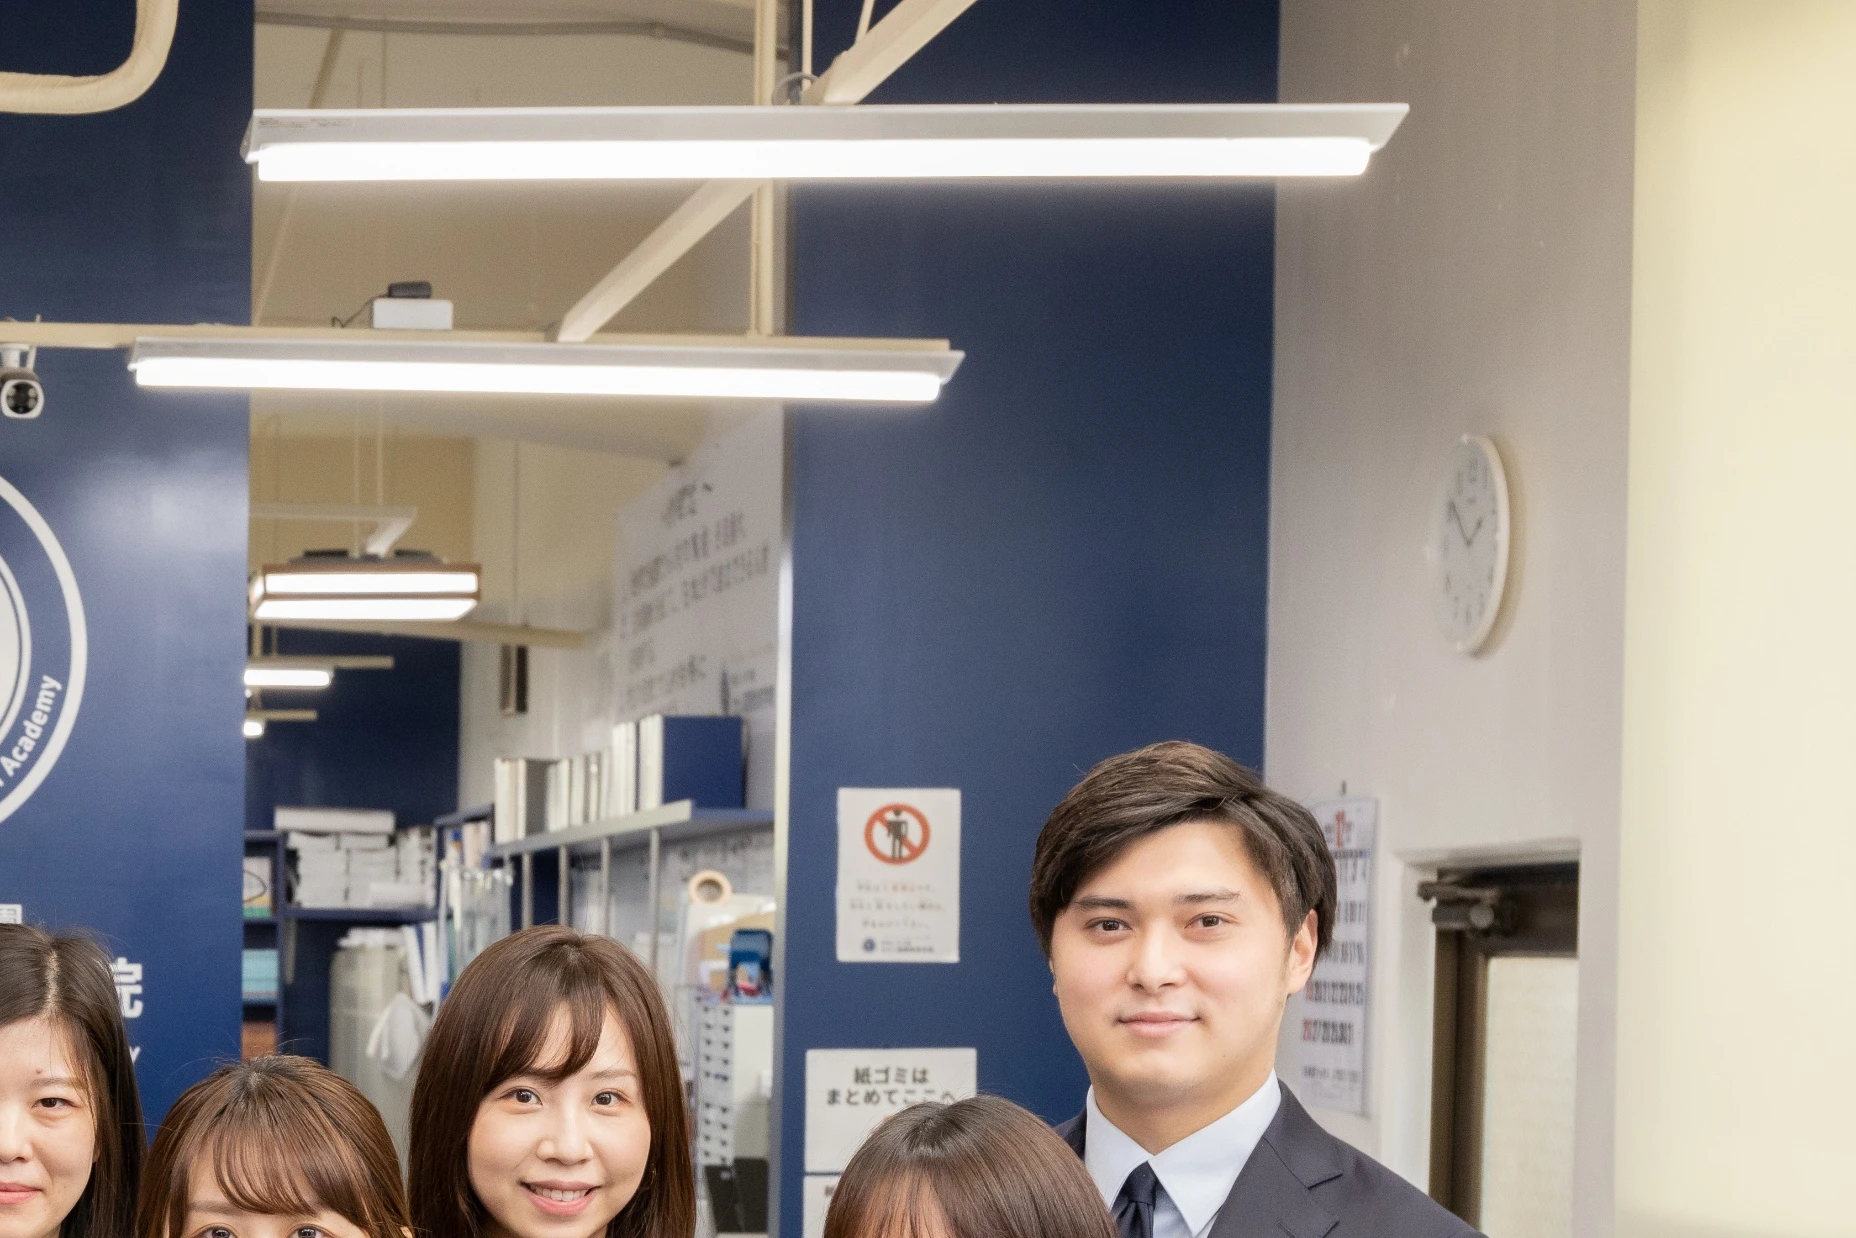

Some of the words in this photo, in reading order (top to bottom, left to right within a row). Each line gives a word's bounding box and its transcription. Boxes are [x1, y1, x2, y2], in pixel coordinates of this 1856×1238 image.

[0, 673, 63, 778] Academy
[853, 1066, 929, 1084] 紙ゴミは
